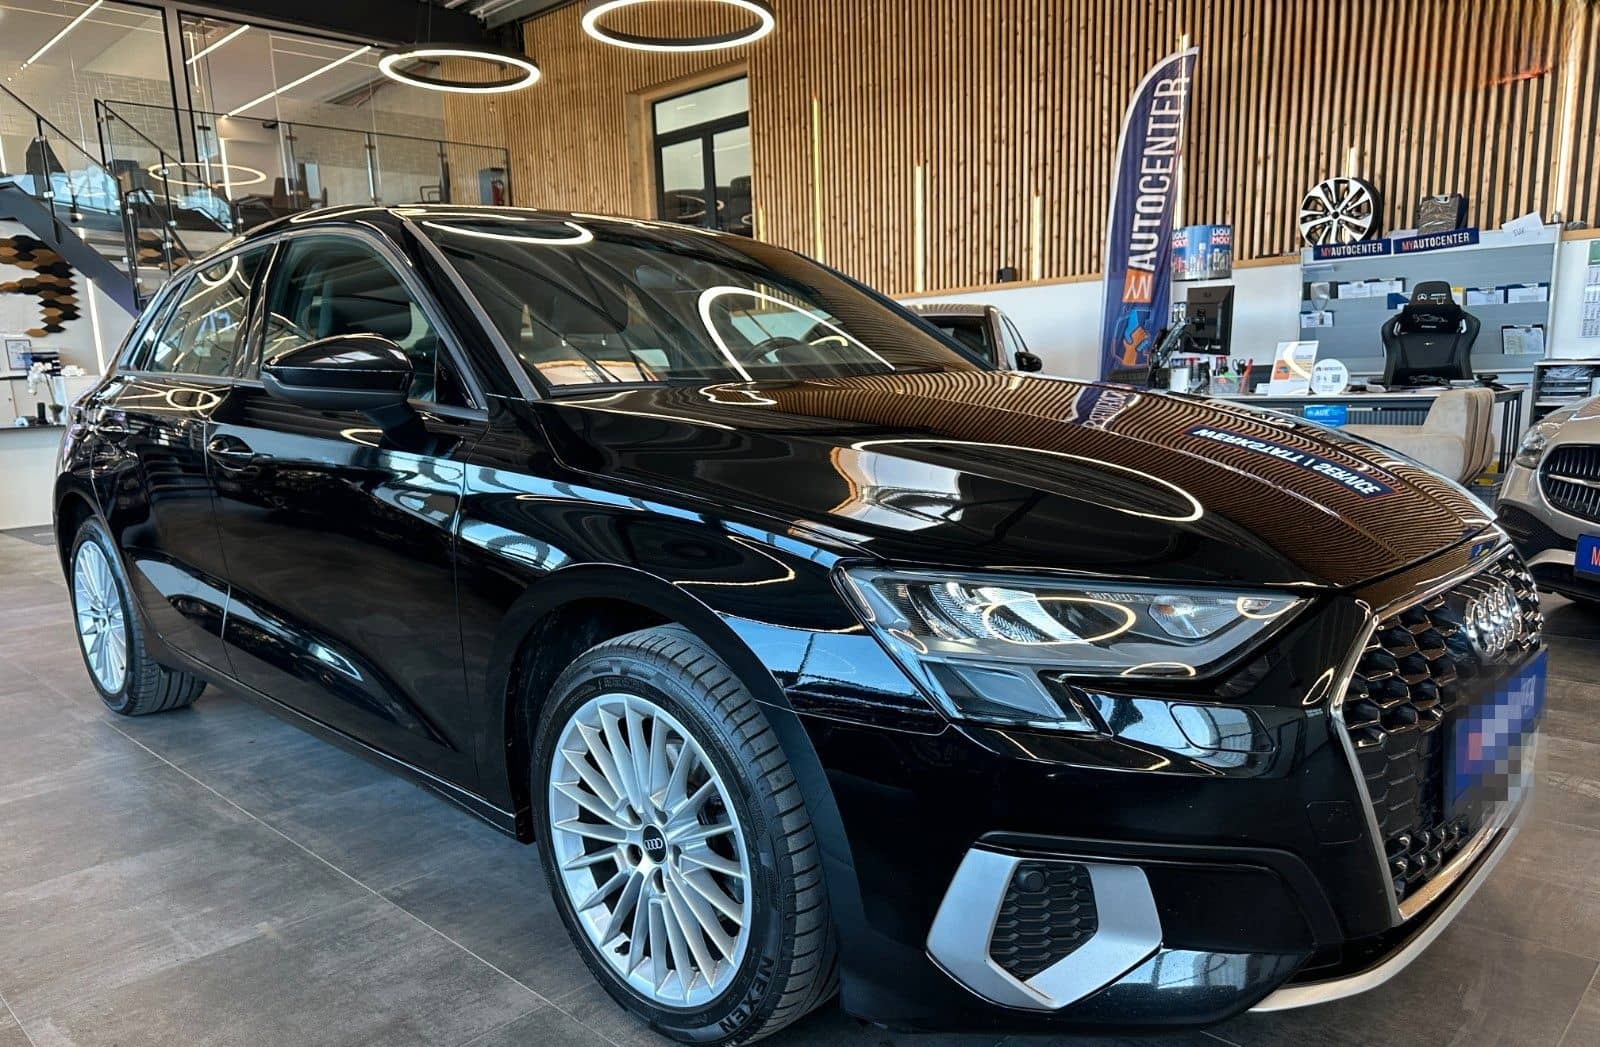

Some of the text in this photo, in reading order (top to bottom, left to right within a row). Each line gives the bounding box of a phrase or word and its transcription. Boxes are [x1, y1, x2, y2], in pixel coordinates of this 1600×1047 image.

[1320, 242, 1383, 257] MYAUTOCENTER
[1402, 231, 1470, 252] MYAUTOCENTER
[719, 956, 774, 1034] NEXEN
